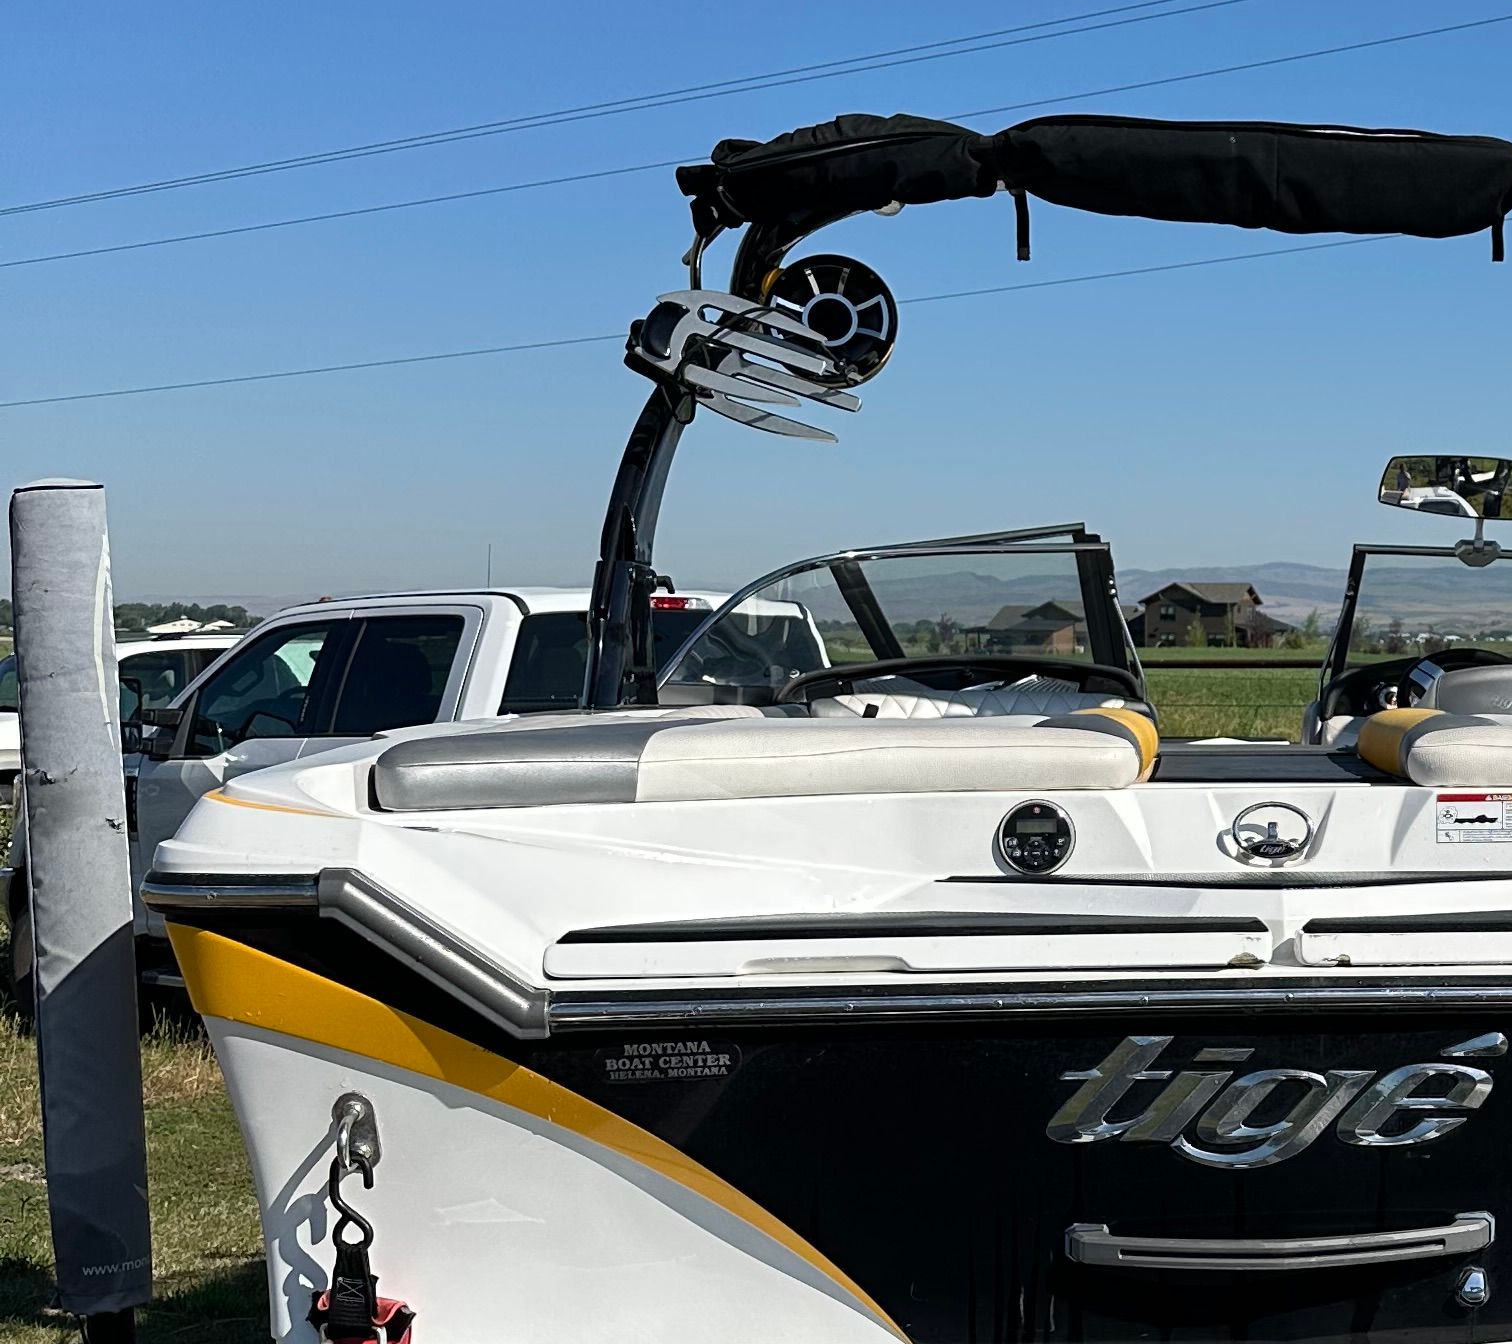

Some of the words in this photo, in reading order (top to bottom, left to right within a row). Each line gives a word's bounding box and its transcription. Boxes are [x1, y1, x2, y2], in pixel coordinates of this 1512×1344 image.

[623, 1041, 712, 1056] MONTANA
[605, 1058, 654, 1071] BOAT
[658, 1054, 731, 1068] CENTER
[667, 1067, 728, 1078] MONTANA
[1046, 1031, 1509, 1169] tigé
